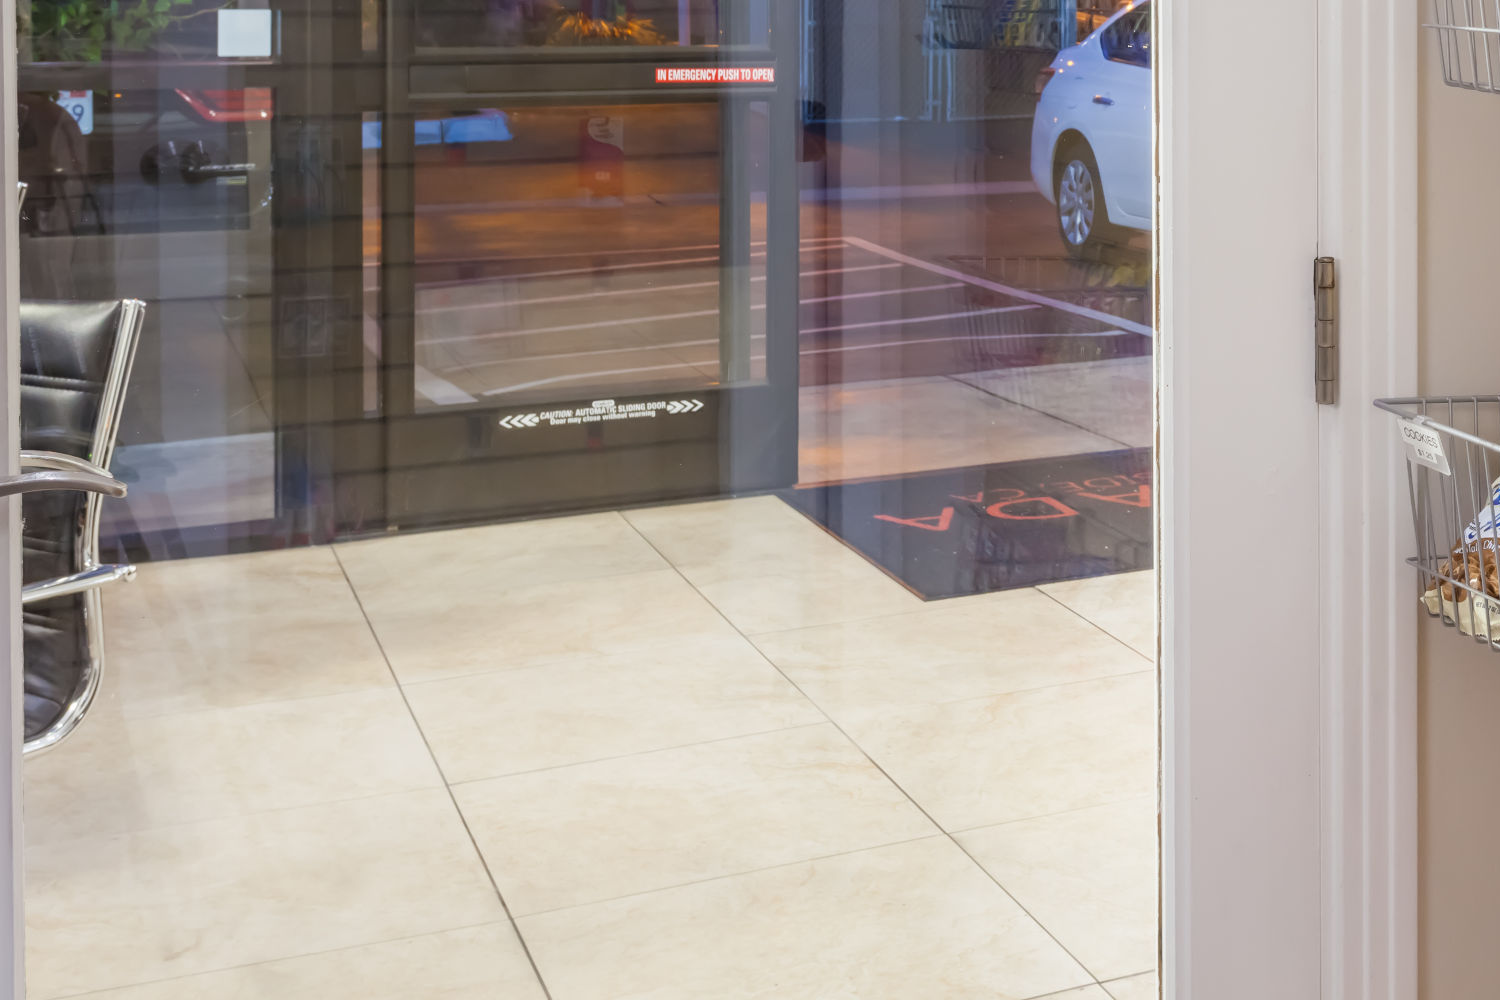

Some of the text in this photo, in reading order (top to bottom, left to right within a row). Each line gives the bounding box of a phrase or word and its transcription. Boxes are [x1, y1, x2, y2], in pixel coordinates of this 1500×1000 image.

[657, 69, 774, 81] IN EMERGENCY PUSH TO OPEN
[575, 406, 616, 418] AUTOMATIC
[617, 403, 646, 414] SLIDING
[646, 401, 667, 410] DOOR
[550, 416, 567, 425] Door
[1403, 426, 1439, 449] COOKIES
